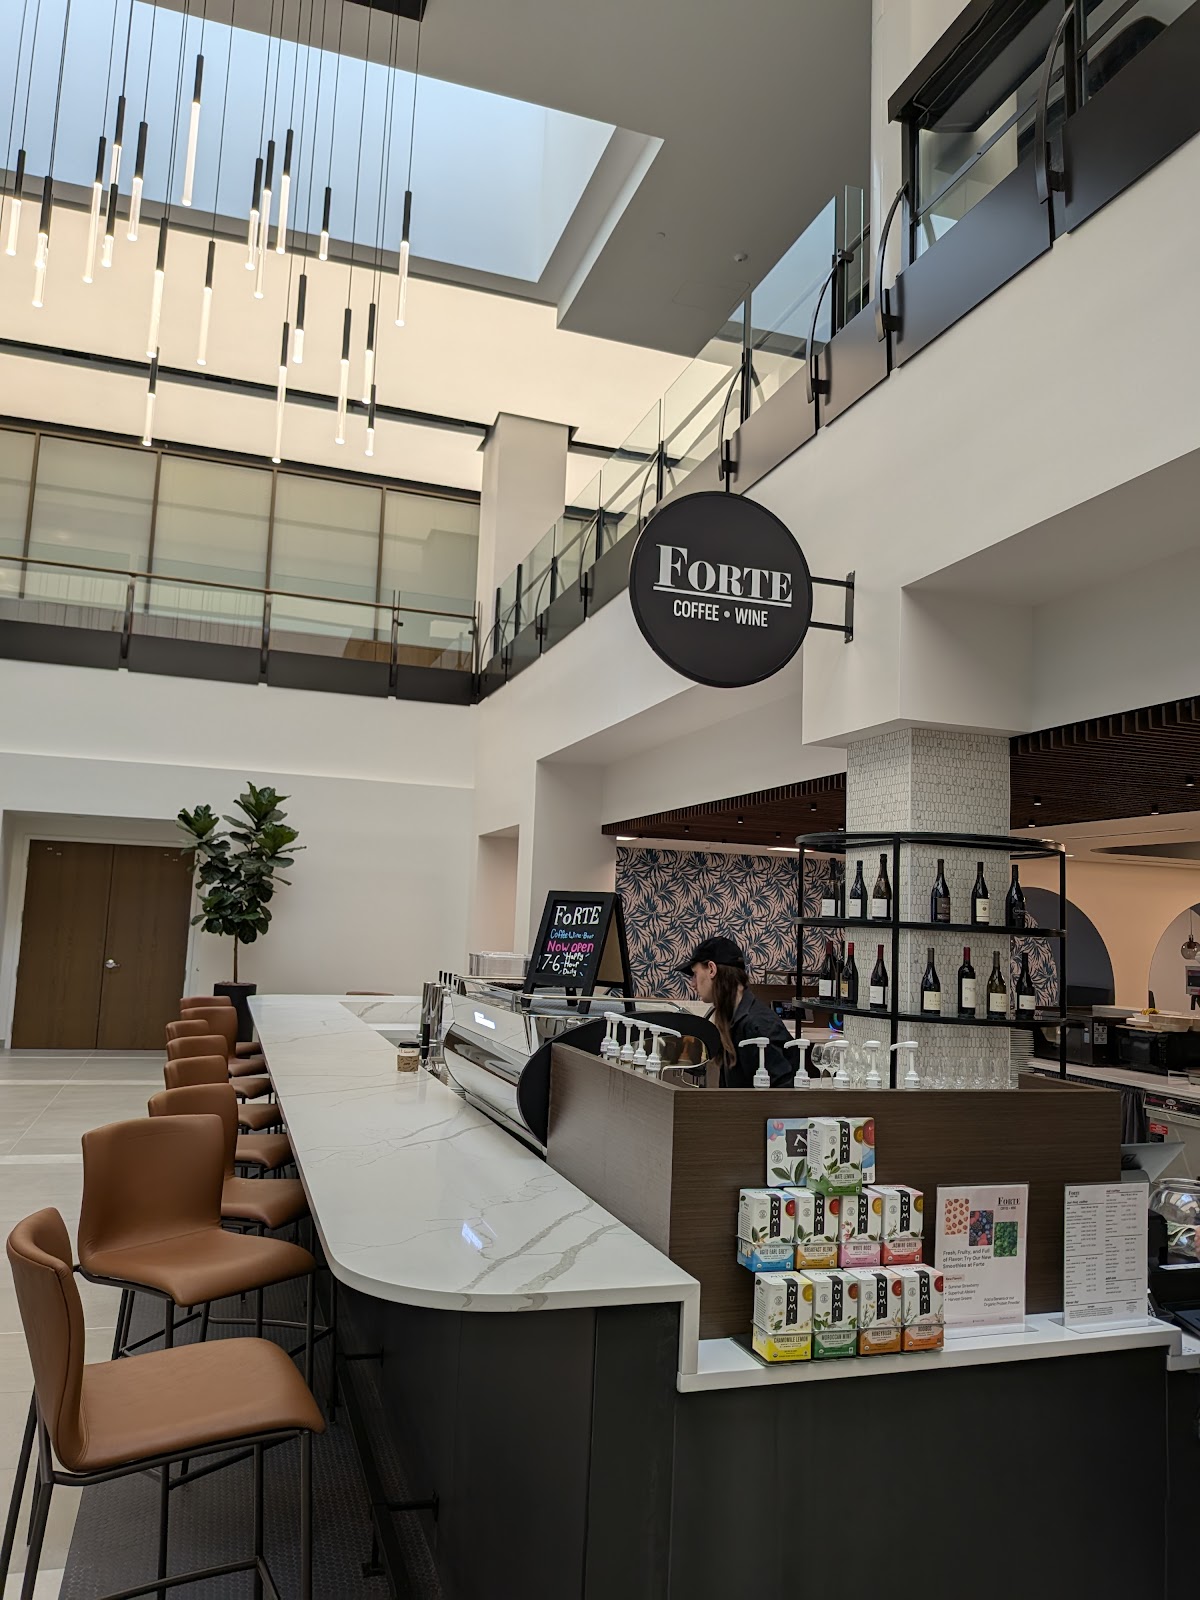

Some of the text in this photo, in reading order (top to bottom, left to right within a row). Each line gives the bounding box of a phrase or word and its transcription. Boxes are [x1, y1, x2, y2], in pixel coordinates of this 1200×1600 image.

[654, 544, 792, 603] FORTE
[673, 599, 768, 627] COFFEE WINE
[547, 940, 570, 952] Now
[565, 952, 584, 961] Happy
[562, 968, 577, 977] Daily
[841, 1128, 849, 1158] NUMI
[771, 1201, 780, 1232] NUMI
[815, 1200, 823, 1230] NUMI
[859, 1198, 867, 1229] NUMI
[901, 1196, 909, 1227] NUMI
[788, 1286, 796, 1319] NUMI
[833, 1284, 841, 1316] NUMI
[878, 1281, 886, 1314] NUMI
[921, 1278, 929, 1309] NUMI
